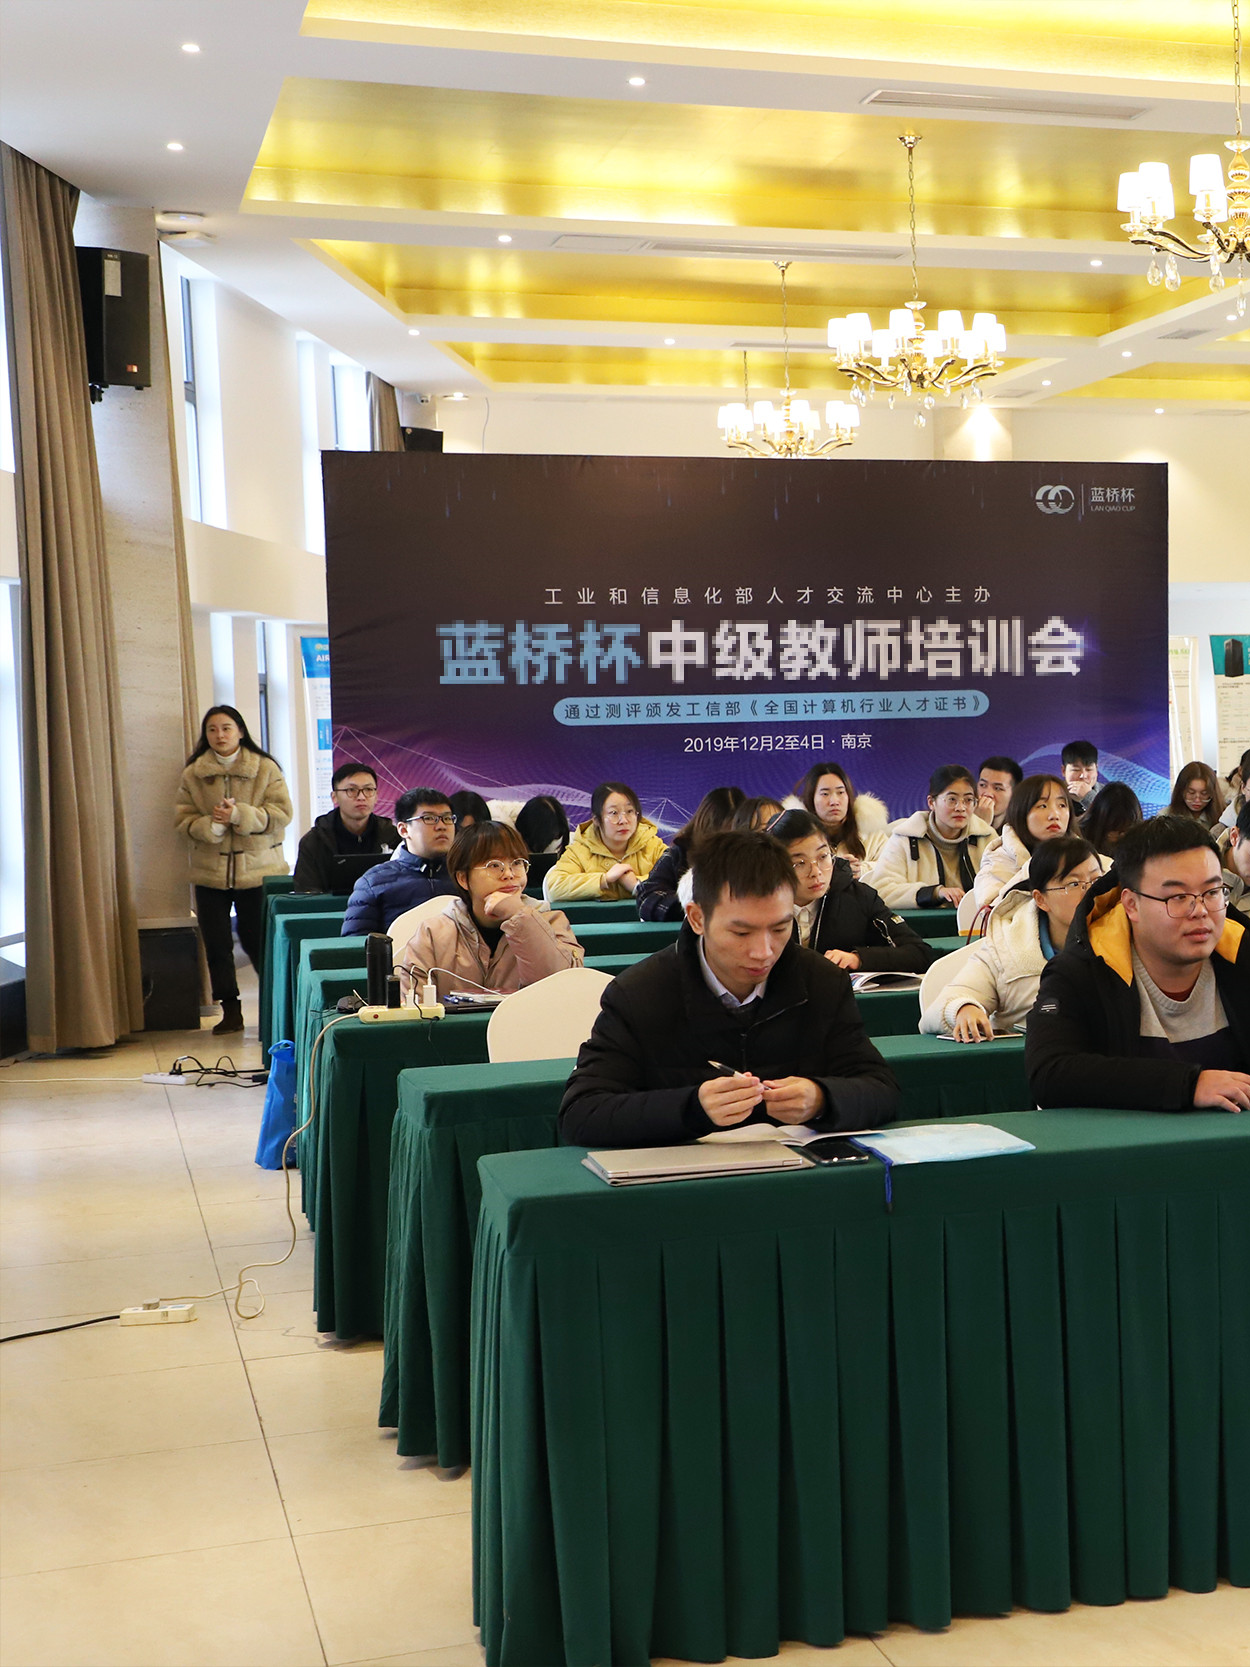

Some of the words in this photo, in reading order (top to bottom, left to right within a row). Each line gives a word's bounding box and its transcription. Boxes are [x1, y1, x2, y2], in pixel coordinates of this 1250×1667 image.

[1090, 486, 1136, 503] 蓝桥杯
[1105, 505, 1121, 513] QIAO
[544, 586, 991, 606] 工业和信息化部人才交流中心主办
[436, 616, 1087, 685] 蓝桥杯中级教师培训会
[564, 696, 981, 720] 通过测评颁发工信部《全国计算机行业人才证书》
